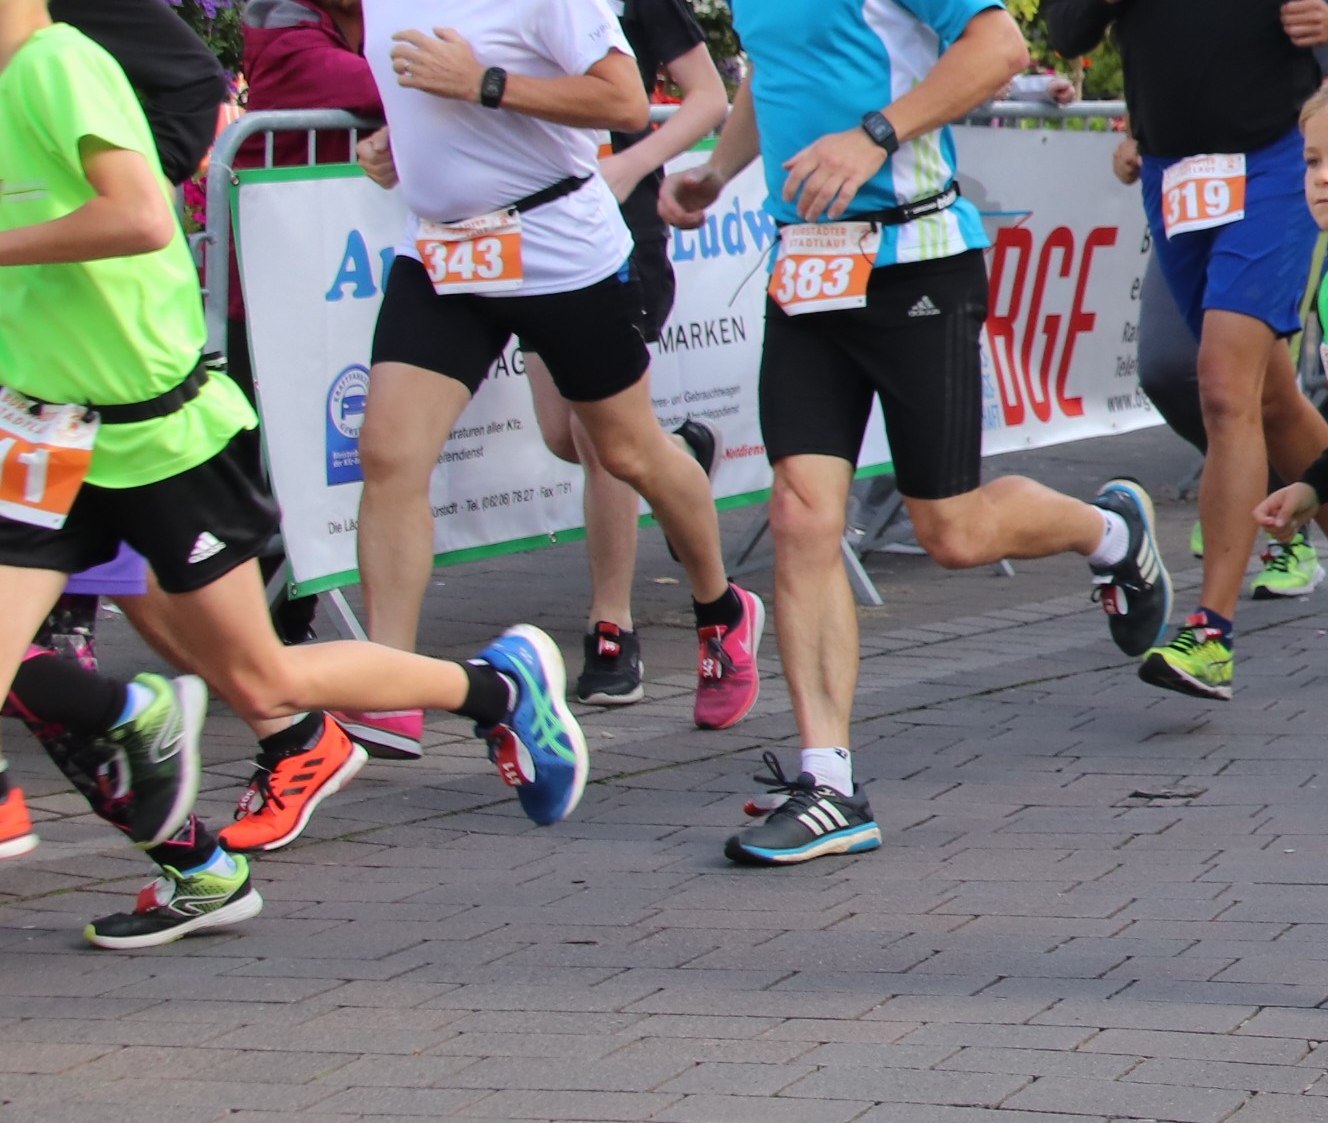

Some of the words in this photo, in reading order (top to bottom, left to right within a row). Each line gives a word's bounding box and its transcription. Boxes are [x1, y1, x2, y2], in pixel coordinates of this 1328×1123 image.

[1167, 180, 1231, 225] 319
[424, 238, 502, 283] 343
[776, 258, 855, 304] 383
[658, 316, 747, 355] MARKEN
